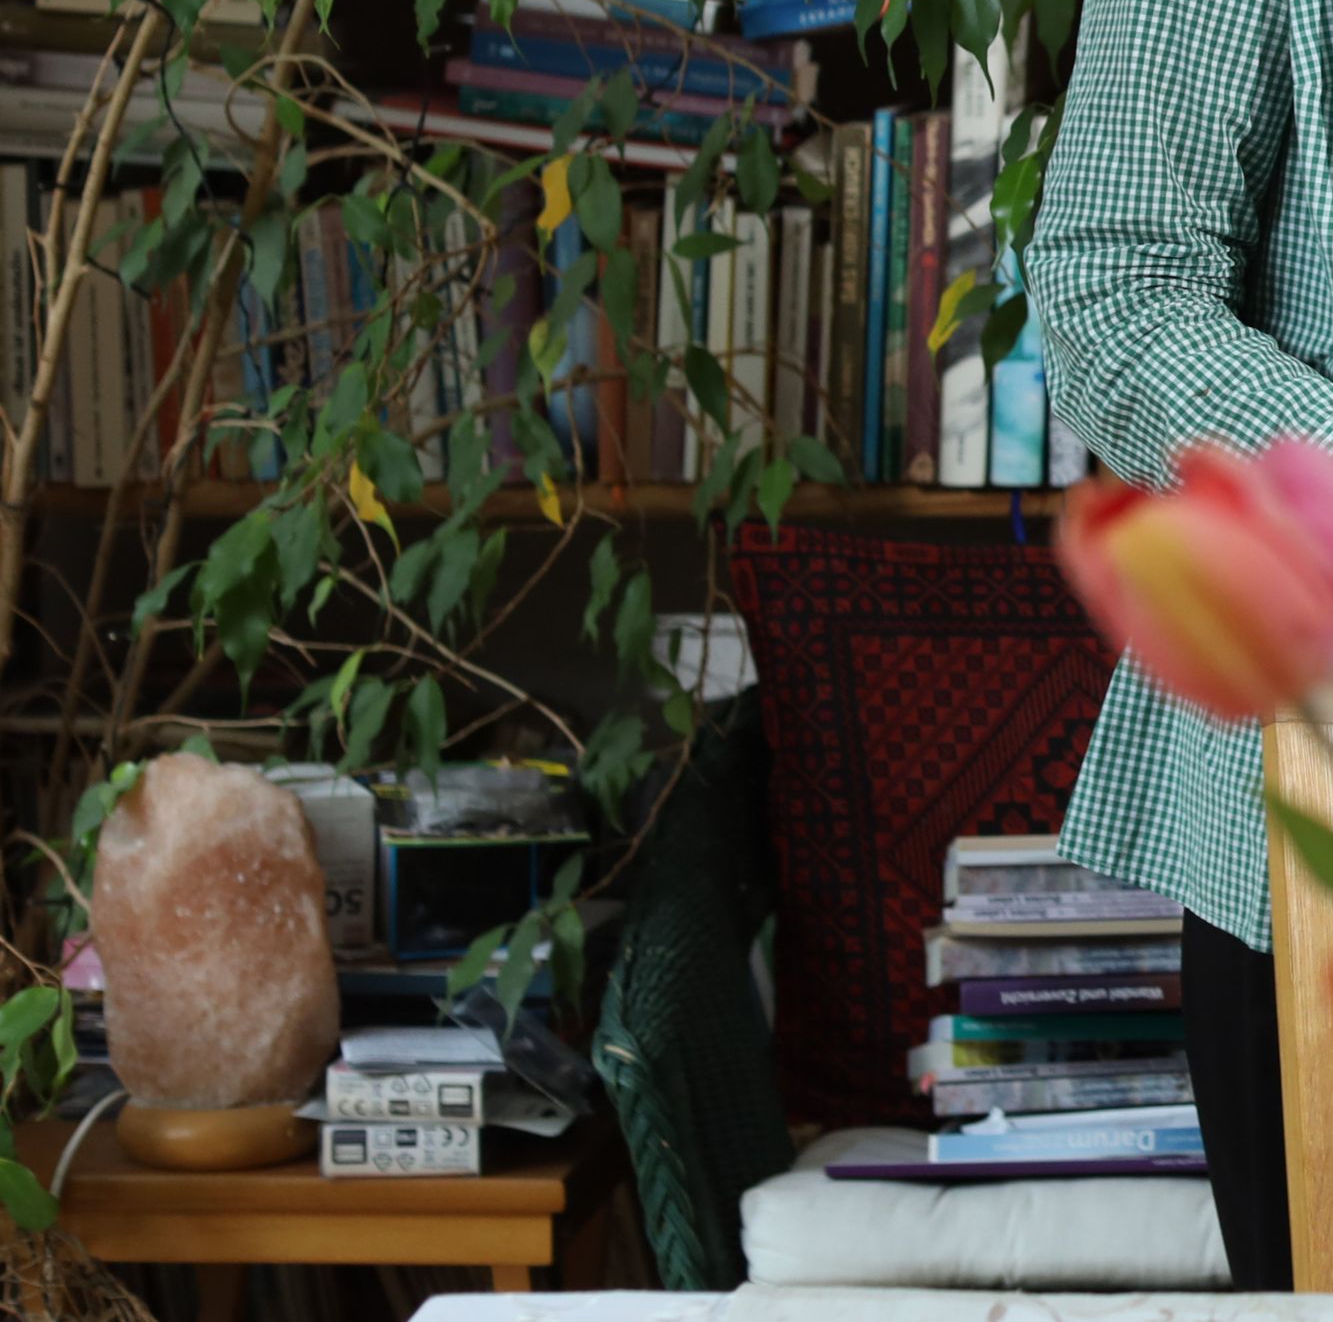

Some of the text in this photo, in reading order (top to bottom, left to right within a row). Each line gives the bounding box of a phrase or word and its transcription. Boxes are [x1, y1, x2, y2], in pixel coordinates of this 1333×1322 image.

[998, 985, 1163, 1008] Wandel und Zuversicht
[1066, 1129, 1156, 1155] Darum
